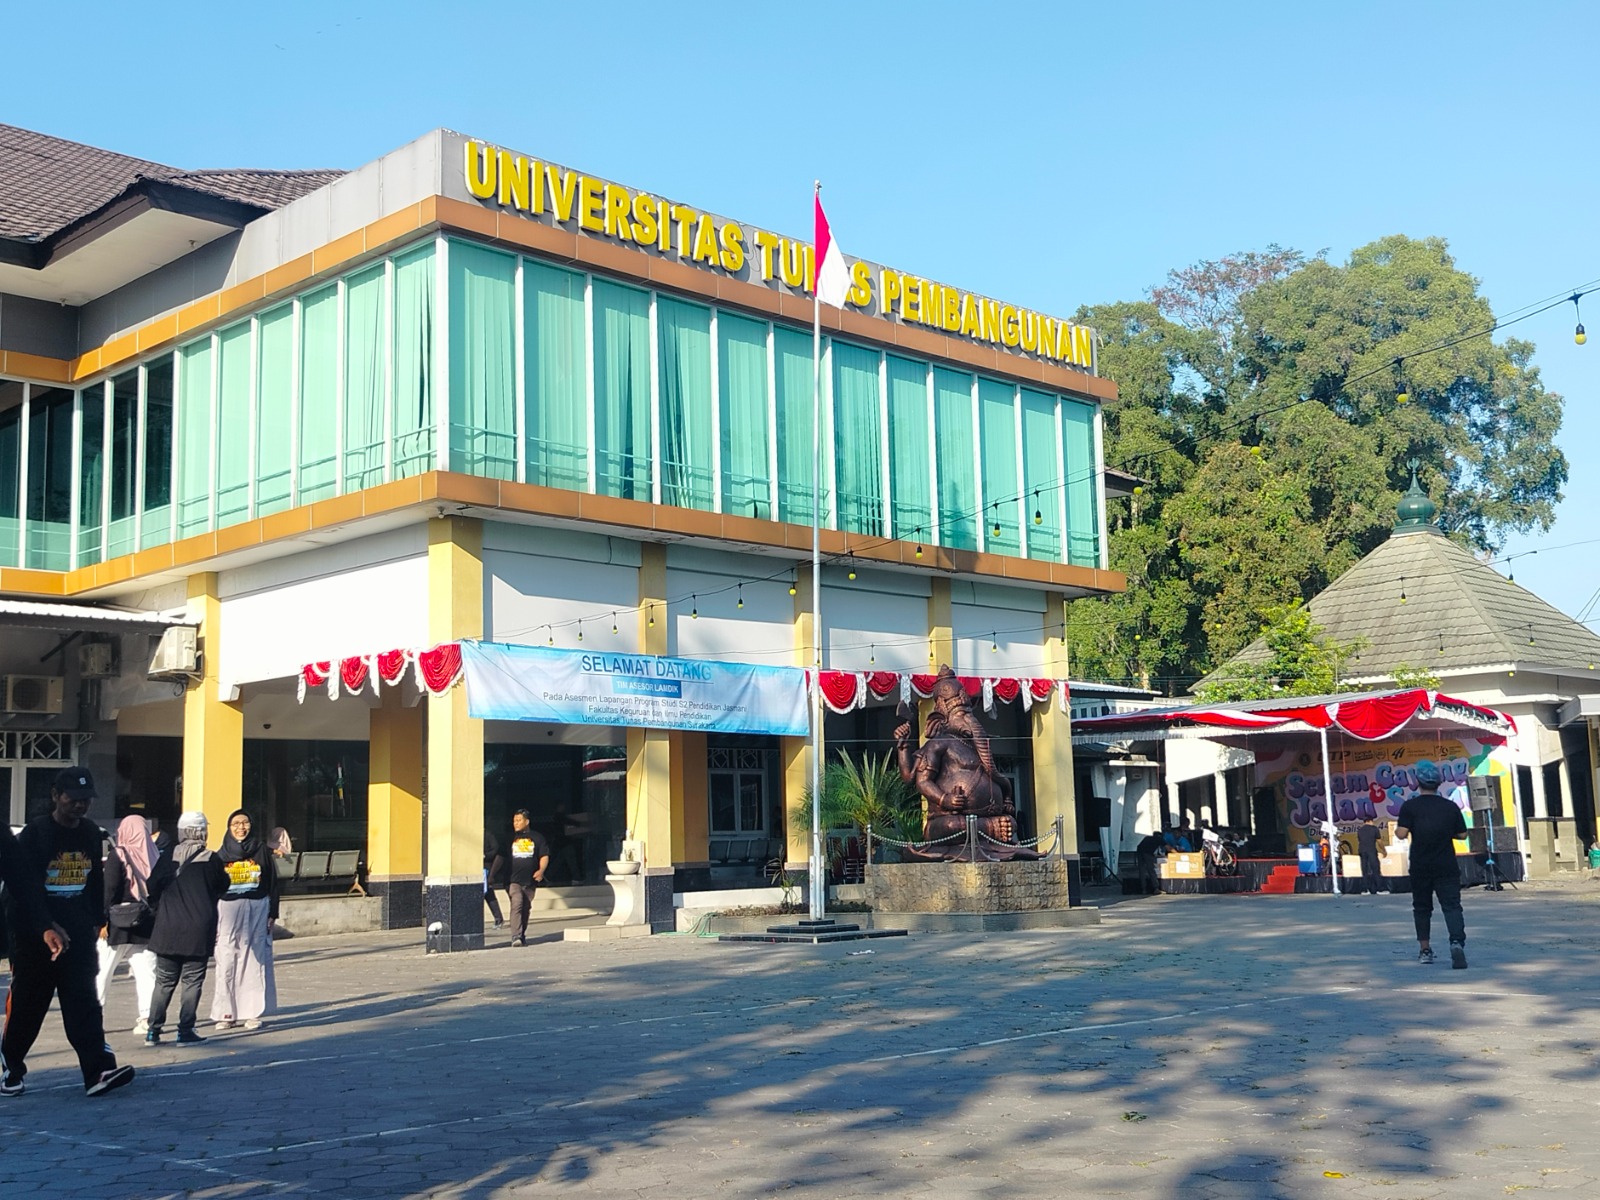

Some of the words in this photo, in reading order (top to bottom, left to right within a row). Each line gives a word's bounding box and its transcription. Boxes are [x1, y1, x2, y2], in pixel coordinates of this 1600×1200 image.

[464, 141, 744, 272] UNIVERSITAS
[754, 230, 872, 307] TUS
[879, 268, 1092, 368] PEMBANGUNAN
[581, 655, 651, 676] SELAMAT
[655, 660, 712, 681] DATANG
[616, 681, 628, 689] TIM
[629, 682, 654, 691] ASESOR
[543, 692, 563, 701] Pada
[564, 693, 598, 703] Asesmen
[599, 694, 633, 706] Lapangan
[634, 697, 660, 708] Program
[661, 699, 677, 707] Studi
[678, 700, 688, 709] S2
[688, 701, 721, 711] Pendidikan
[722, 703, 747, 713] Jasmani
[581, 714, 620, 724] Universitas
[621, 715, 642, 726] Tunas
[642, 718, 687, 728] Pembangunan
[588, 704, 619, 714] Fakultas
[620, 706, 651, 717] Keguruan
[651, 709, 663, 718] dan
[679, 711, 712, 720] Pendidikan
[1375, 762, 1468, 791] Gayng
[46, 877, 88, 885] PASSIO
